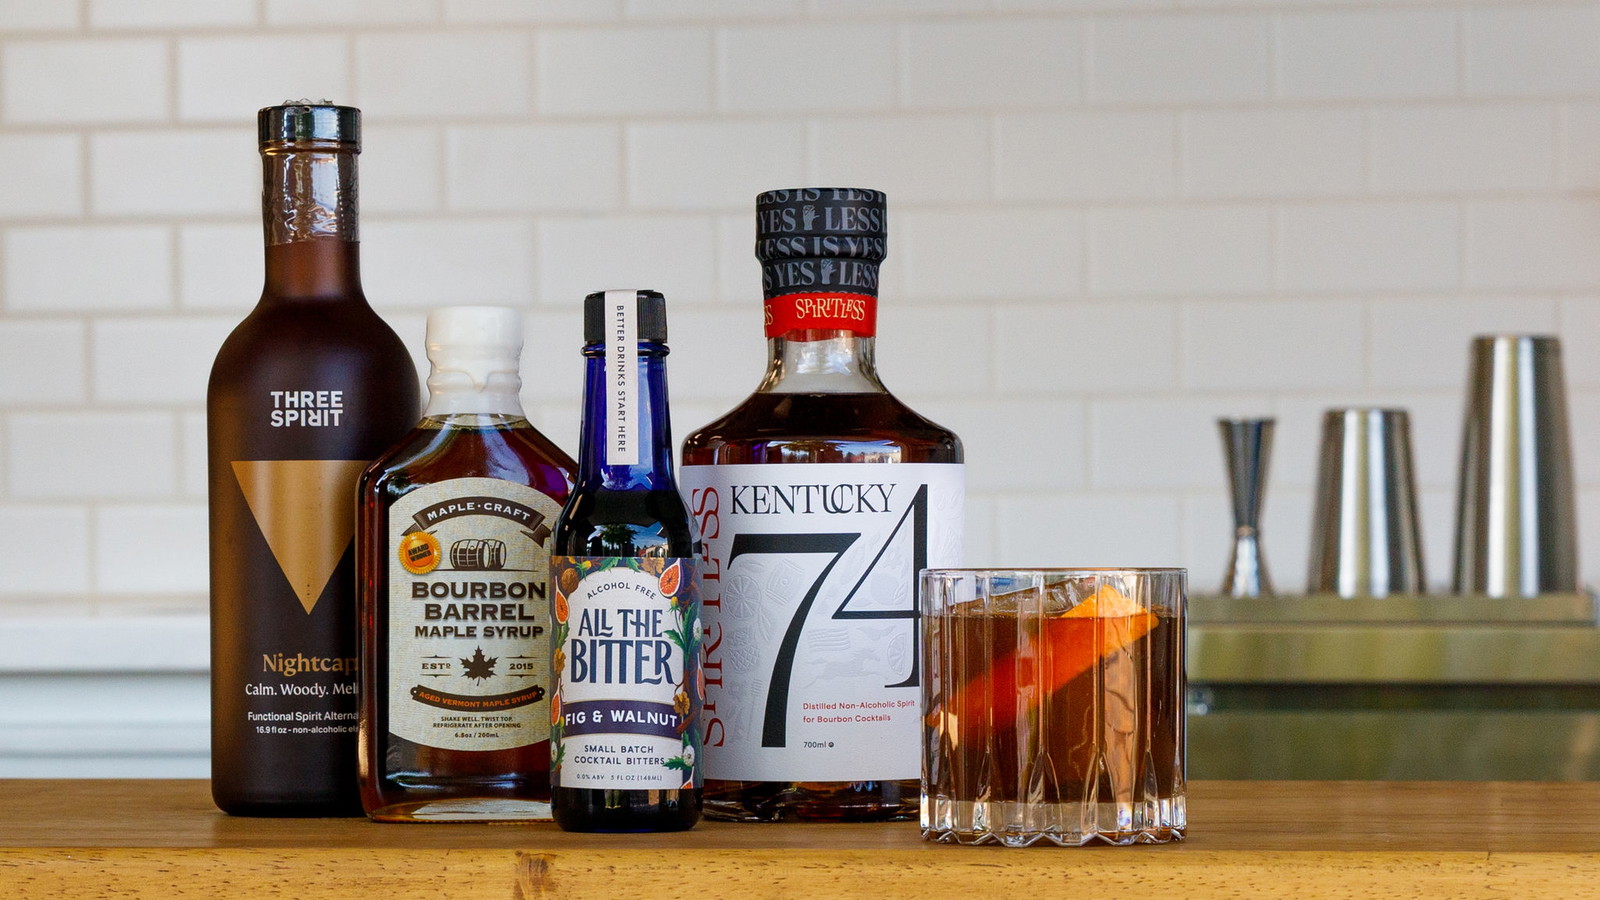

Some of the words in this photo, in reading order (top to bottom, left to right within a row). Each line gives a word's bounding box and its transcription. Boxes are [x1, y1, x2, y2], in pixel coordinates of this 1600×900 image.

[759, 207, 797, 234] YES
[824, 206, 880, 233] LESS
[813, 236, 840, 257] IS
[845, 236, 883, 260] YES
[774, 260, 816, 288] YES
[839, 261, 878, 290] LESS
[795, 298, 866, 321] SPIRITLESS
[616, 305, 625, 342] BETTER
[617, 346, 626, 387] DRINKS
[270, 390, 344, 409] THREE
[617, 391, 626, 422] START
[270, 409, 344, 428] SPIRIT
[617, 426, 626, 452] HERE
[730, 483, 897, 515] KENTUCKY
[408, 543, 429, 556] AWARD
[411, 581, 546, 599] BOURBON
[587, 581, 631, 600] ALCOHOL
[634, 584, 657, 600] FREE
[424, 603, 535, 621] BARREL
[727, 483, 929, 748] 74
[414, 625, 477, 638] MAPLE
[483, 625, 544, 638] SYRUP
[578, 608, 614, 638] ALL
[617, 608, 663, 638] THE
[509, 662, 534, 670] 2015
[570, 638, 675, 685] BITTER
[245, 682, 278, 696] Calm.
[280, 682, 329, 698] Woody.
[419, 691, 441, 703] AGED
[442, 697, 480, 708] VERMONT
[482, 698, 511, 708] MAPLE
[511, 691, 538, 704] SYRUP
[803, 702, 837, 710] Distilled
[839, 700, 895, 710] Non-Alcoholic
[896, 699, 915, 709] Spirit
[247, 711, 294, 721] Functional
[295, 711, 322, 723] Spirit
[565, 710, 586, 727] FIG
[592, 709, 603, 724] &
[610, 709, 678, 728] WALNUT
[803, 715, 815, 723] for
[817, 715, 853, 723] Bourbon
[855, 713, 891, 723] Cocktails
[256, 725, 271, 734] 16.9
[292, 725, 347, 734] non-alcoholic
[584, 745, 616, 753] SMALL
[620, 745, 654, 754] BATCH
[803, 741, 827, 749] 700ml
[574, 755, 622, 765] COCKTAIL
[626, 757, 665, 765] BITTERS
